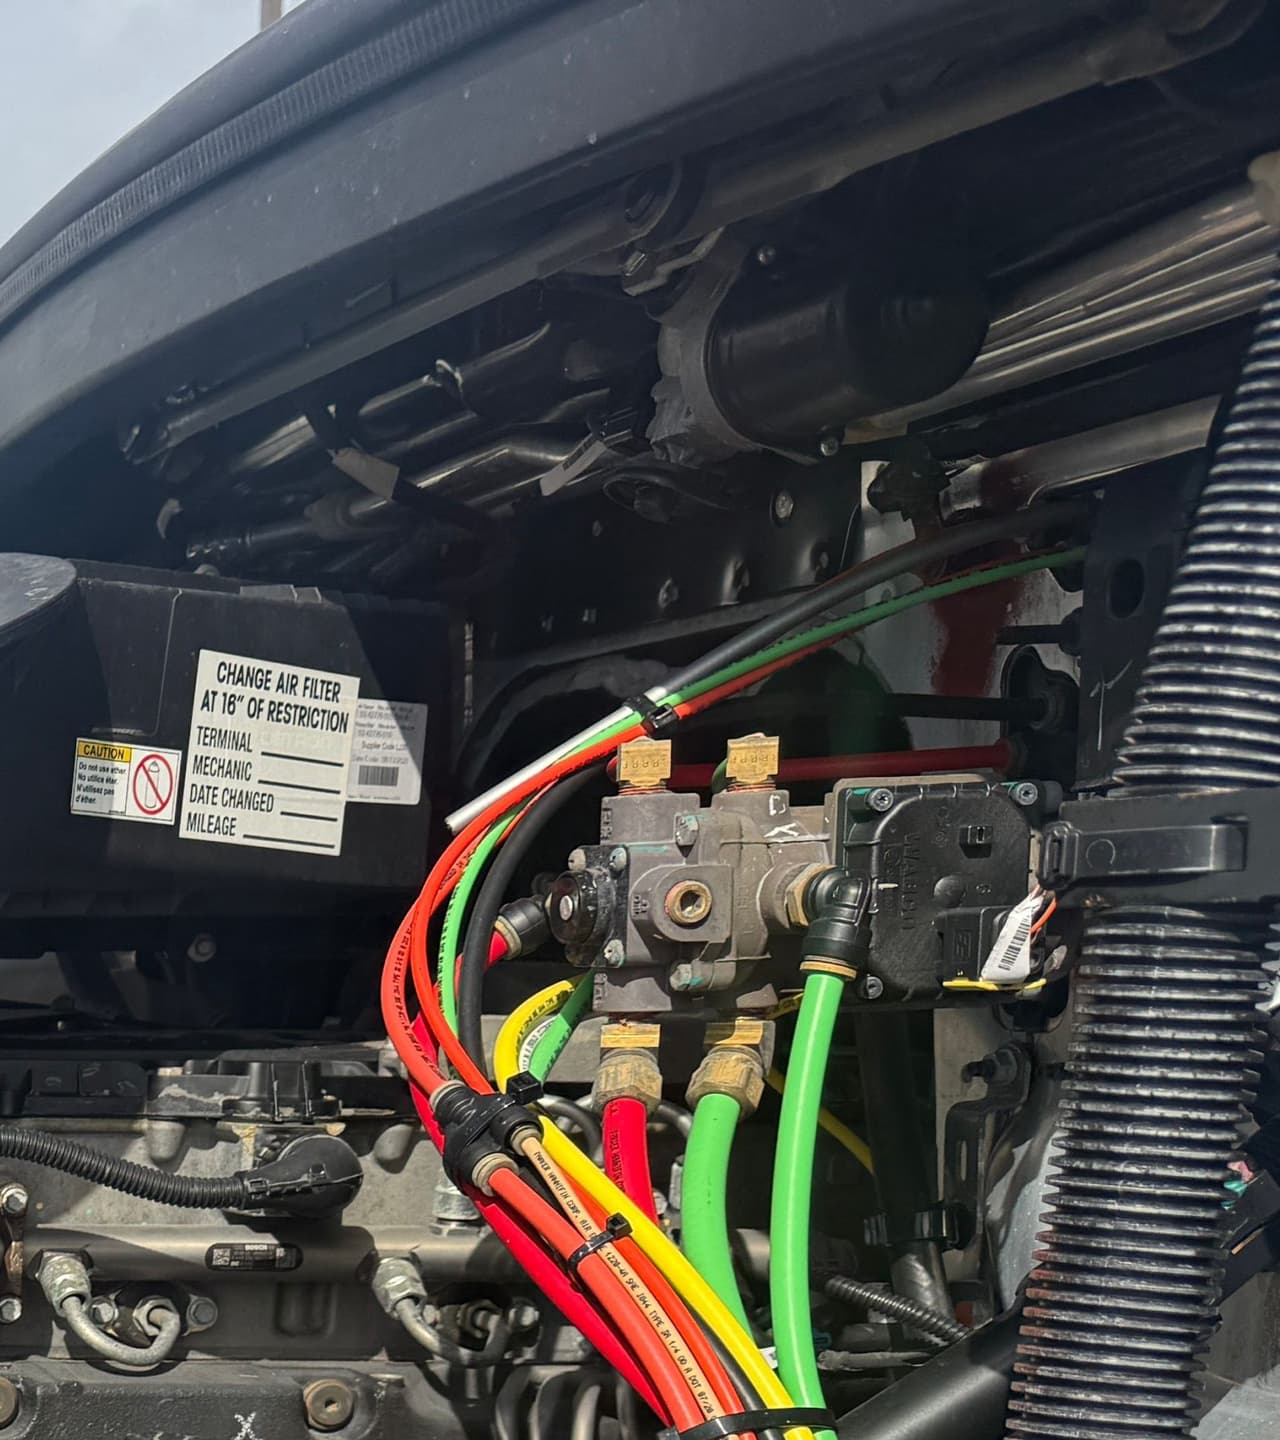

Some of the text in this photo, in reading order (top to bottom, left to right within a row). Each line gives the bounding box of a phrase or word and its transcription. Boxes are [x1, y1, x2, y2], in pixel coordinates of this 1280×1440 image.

[217, 661, 341, 703] CHANGE AIR FILTER
[200, 689, 215, 713] AT
[247, 699, 264, 720] OF
[267, 699, 349, 734] RESTRICTION
[83, 744, 125, 760] CAUTION
[196, 725, 254, 753] TERMINAL
[192, 755, 252, 781] MECHANIC
[189, 784, 274, 813] DATE CHANGED
[186, 812, 237, 836] MILEAGE
